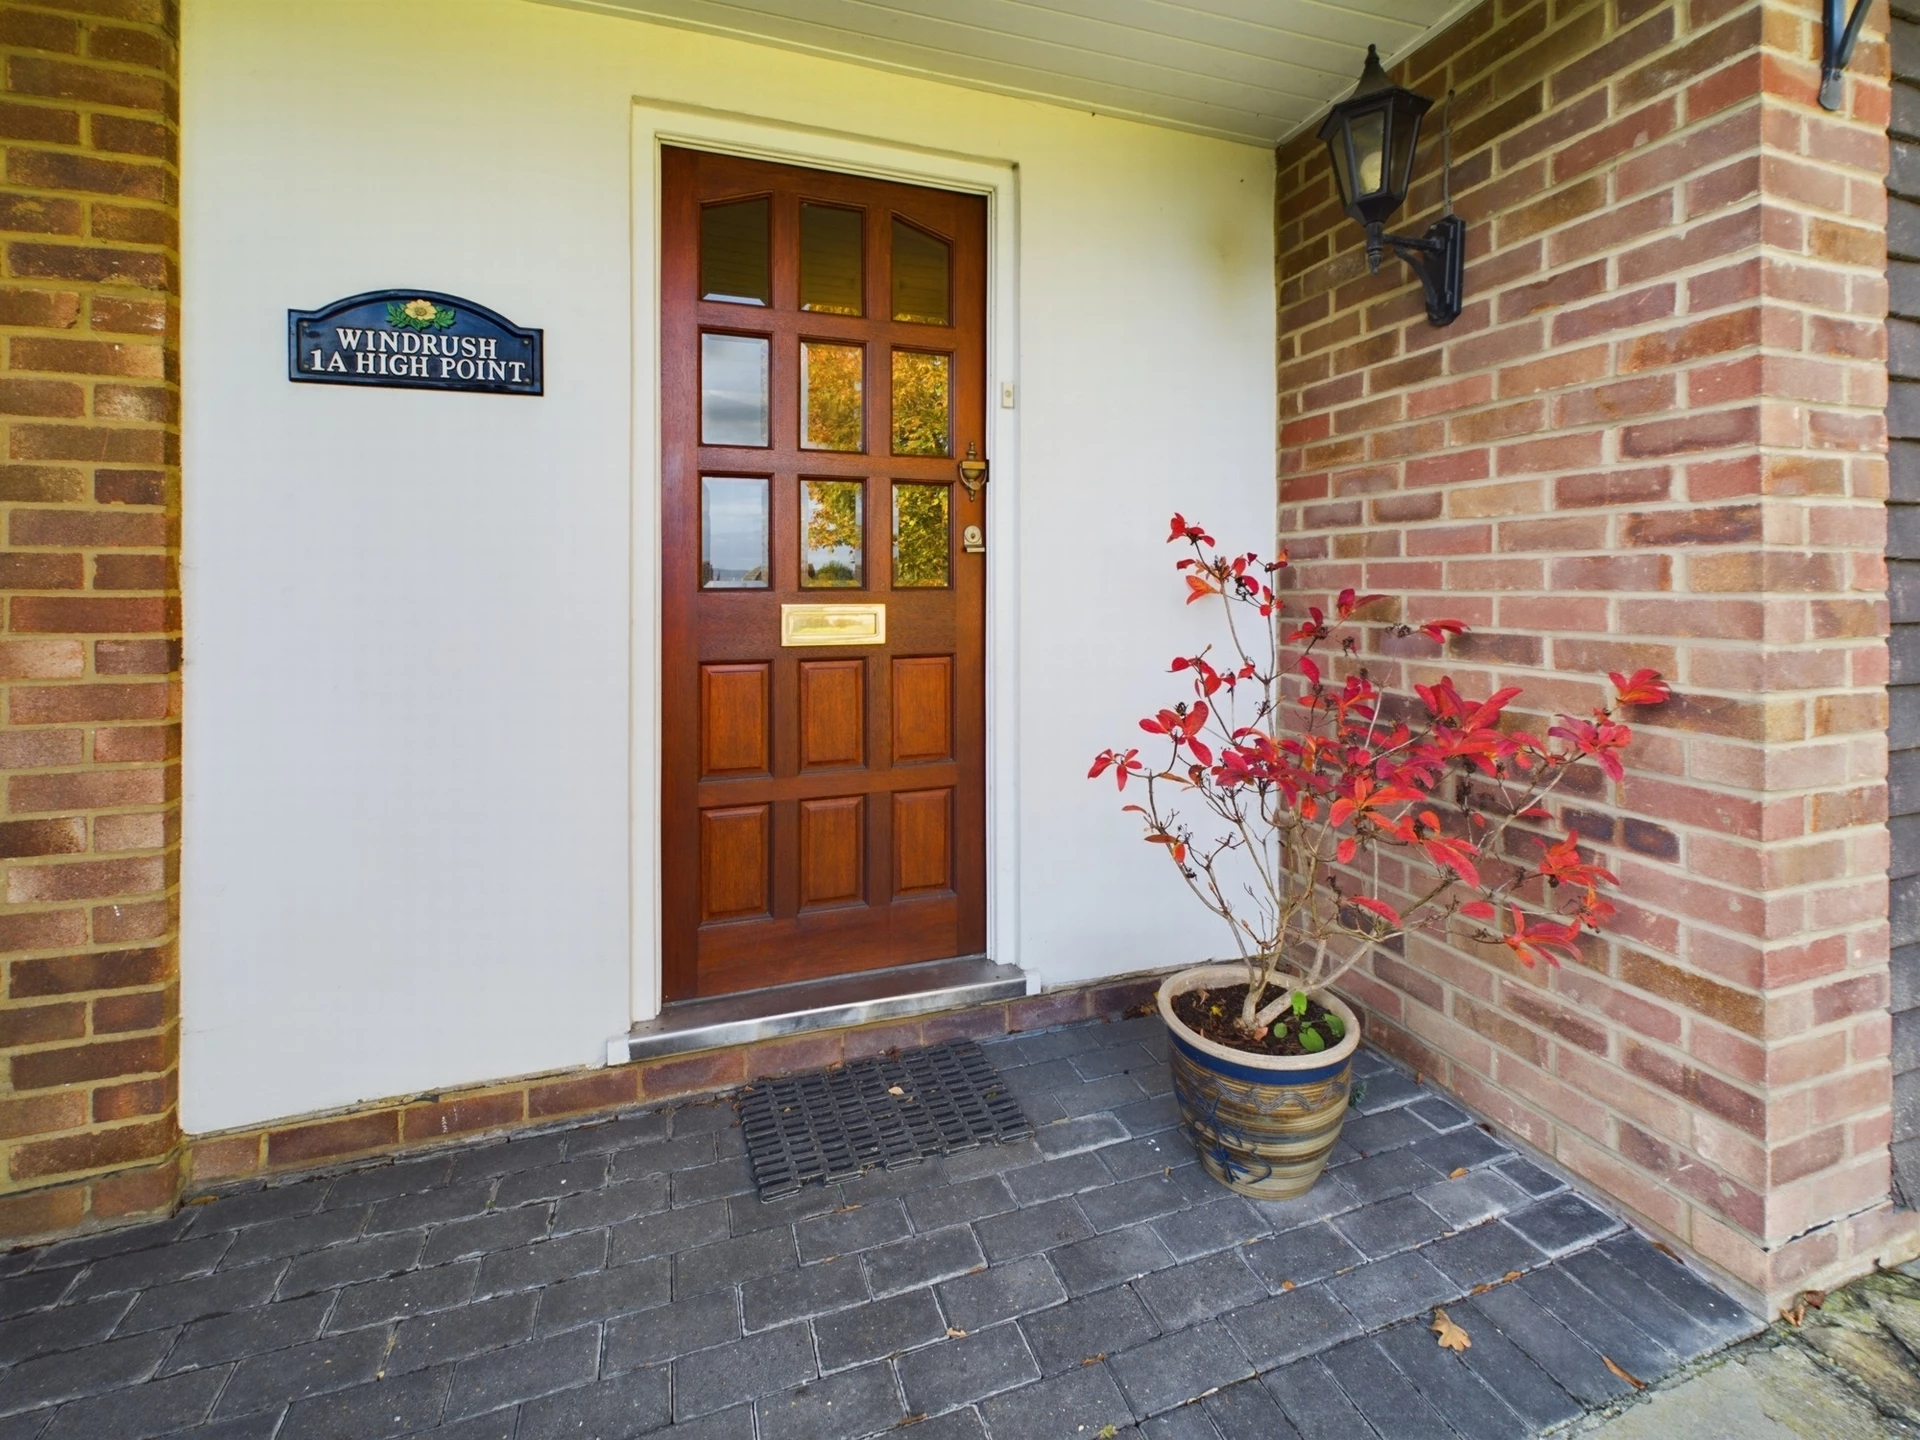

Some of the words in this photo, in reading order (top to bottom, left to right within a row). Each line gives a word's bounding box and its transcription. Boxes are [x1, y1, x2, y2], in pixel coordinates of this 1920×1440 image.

[336, 328, 498, 359] WINDRUSH
[311, 350, 347, 373] 1A
[356, 352, 430, 378] HIGH
[440, 359, 526, 383] POINT
